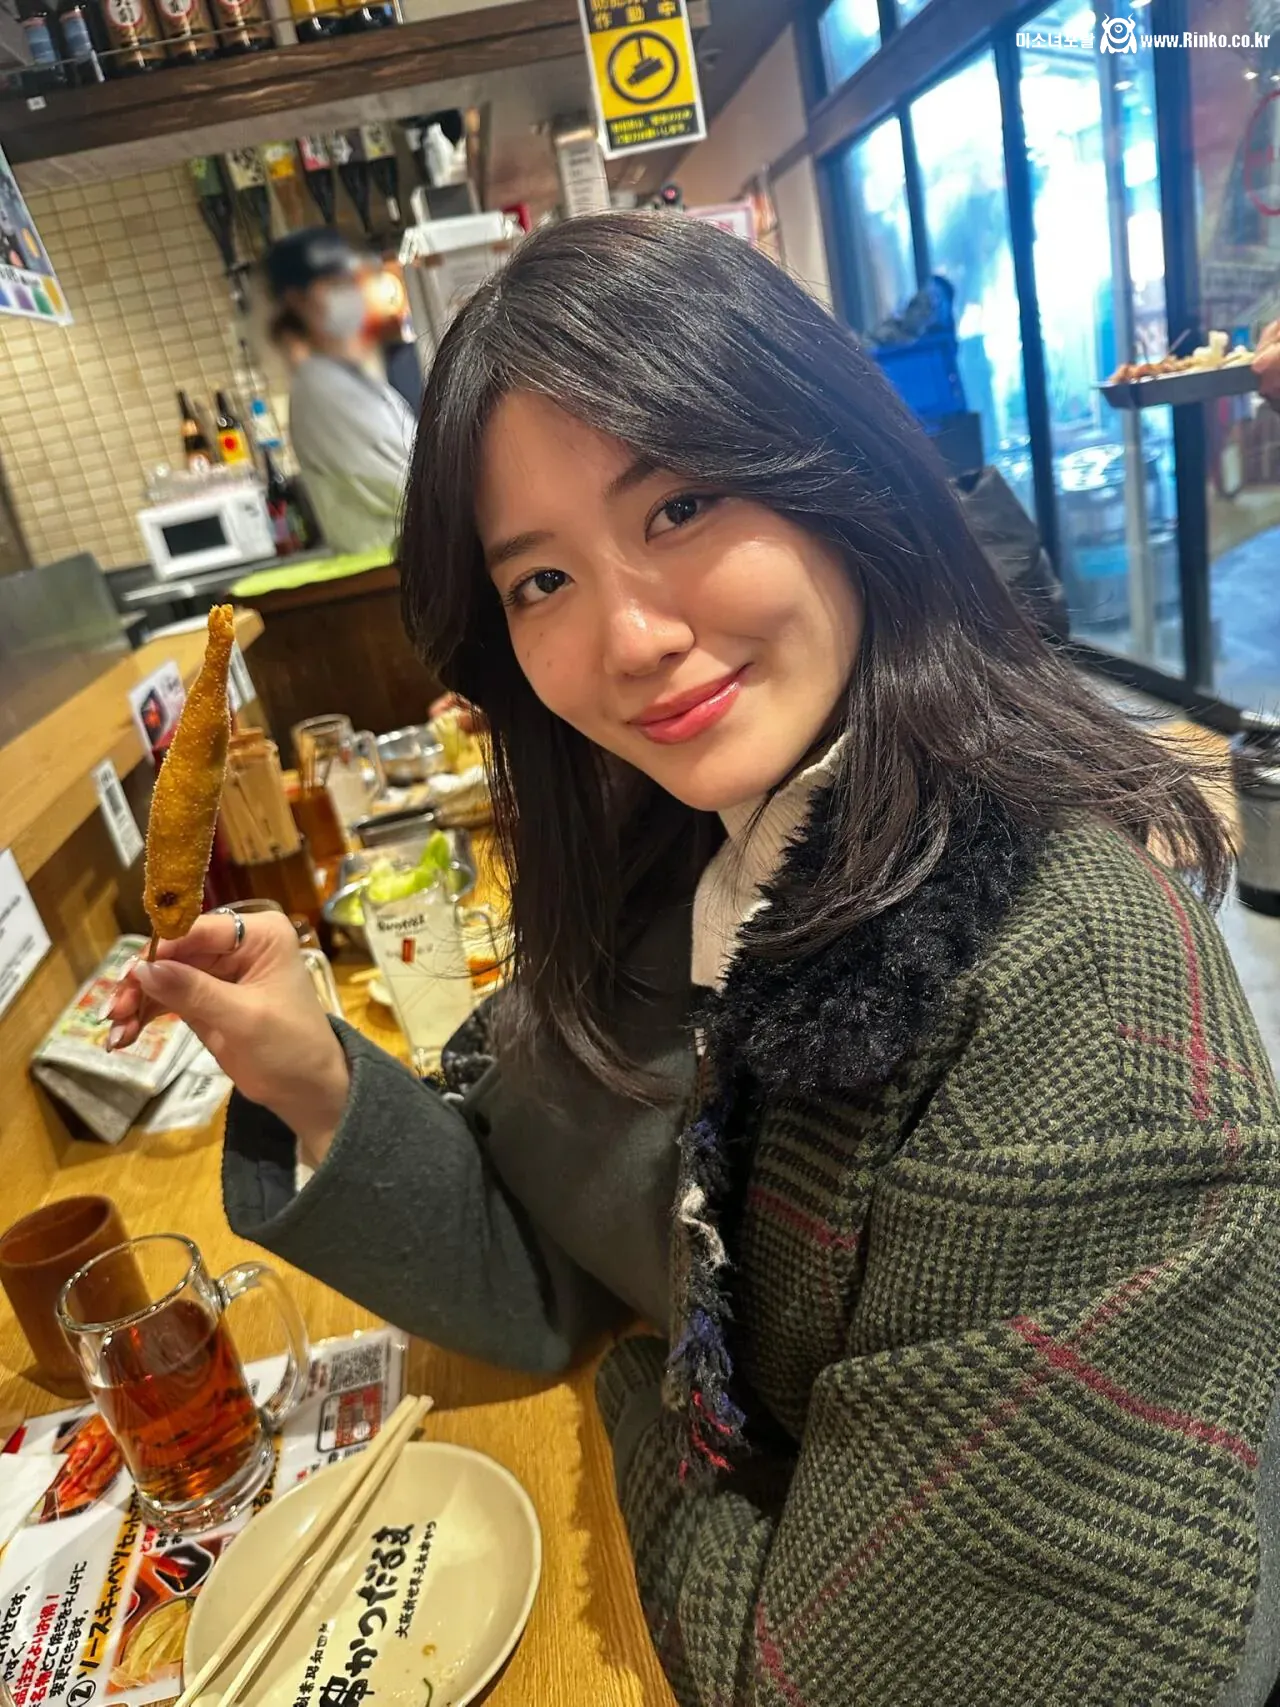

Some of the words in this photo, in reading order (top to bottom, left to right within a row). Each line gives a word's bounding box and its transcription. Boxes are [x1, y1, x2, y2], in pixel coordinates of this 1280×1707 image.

[49, 1609, 89, 1698] 変更できます。
[320, 1524, 415, 1707] 串かつだるま
